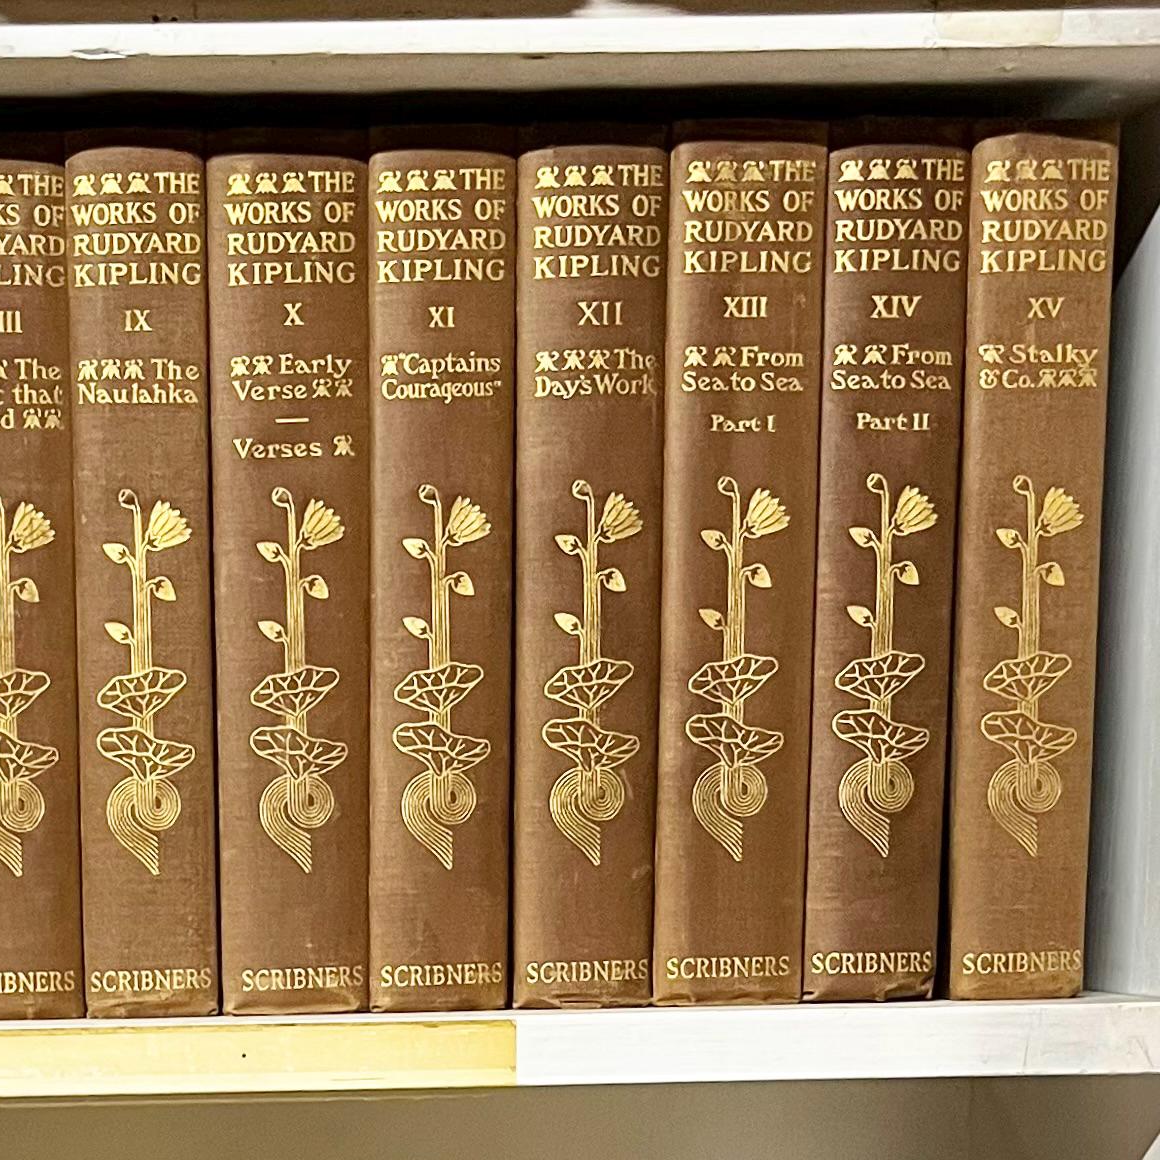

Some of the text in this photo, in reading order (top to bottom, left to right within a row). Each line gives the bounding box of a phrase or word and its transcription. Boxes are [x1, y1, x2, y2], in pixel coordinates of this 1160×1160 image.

[308, 171, 355, 192] THE
[223, 201, 355, 225] WORKS OF
[227, 232, 355, 255] RUDYARD
[228, 261, 355, 286] KIPLING
[284, 303, 304, 326] X
[724, 296, 767, 318] XIII
[614, 347, 655, 369] The
[740, 346, 804, 367] From
[890, 343, 952, 365] From
[1010, 344, 1098, 371] Stalky
[14, 358, 61, 380] The
[151, 359, 199, 380] The
[279, 353, 352, 378] Early
[679, 371, 803, 391] Sea to Sea
[830, 369, 951, 390] Sea to Sea
[1002, 369, 1035, 388] Co.
[77, 382, 198, 404] Naulahka
[232, 380, 307, 400] Verse
[711, 415, 761, 432] Part
[857, 413, 930, 430] Part II
[233, 438, 323, 458] Verses
[667, 956, 789, 980] SCRIBNERS
[90, 968, 211, 993] SCRIBNERS
